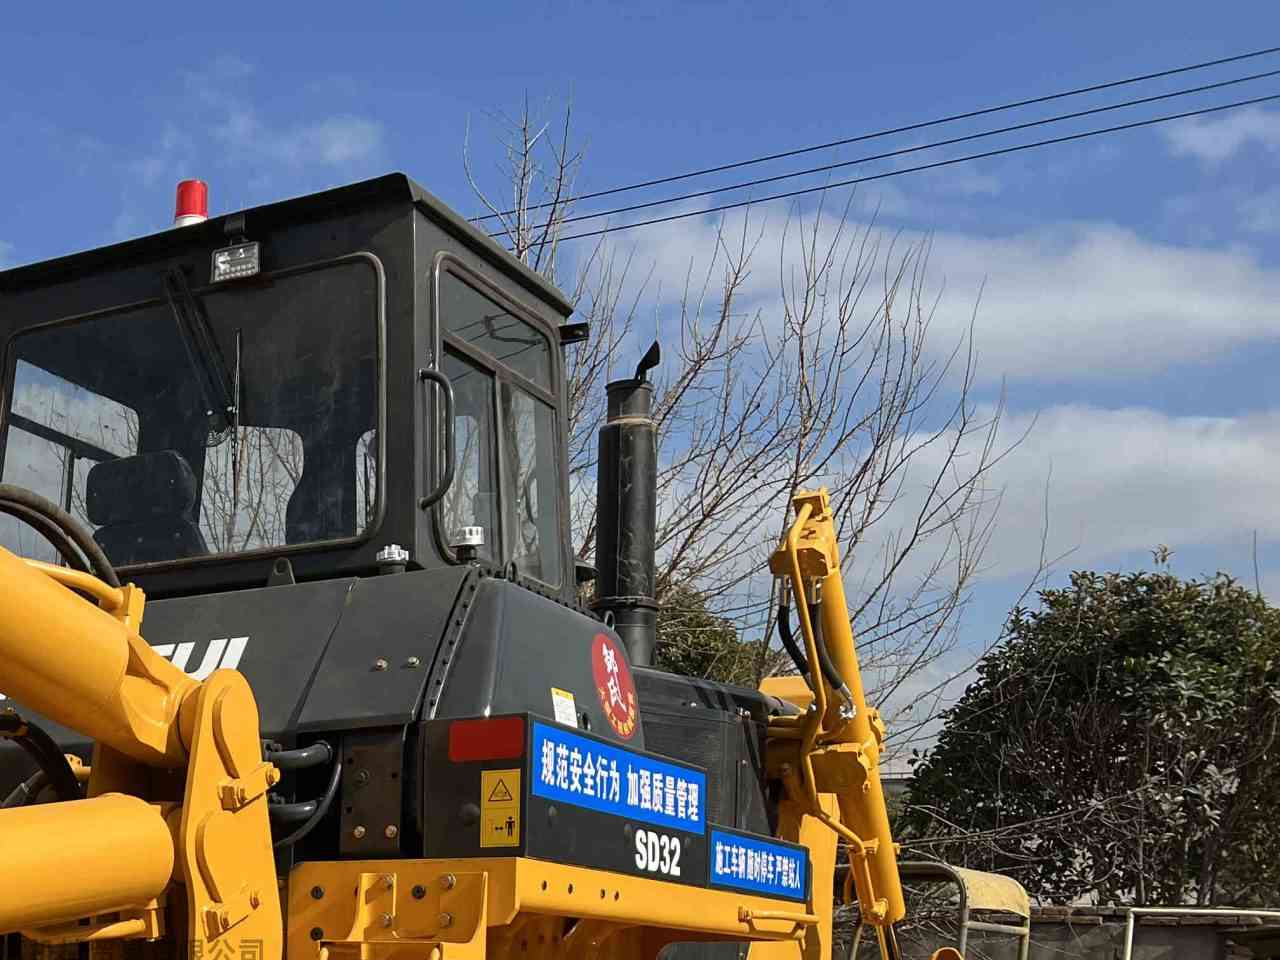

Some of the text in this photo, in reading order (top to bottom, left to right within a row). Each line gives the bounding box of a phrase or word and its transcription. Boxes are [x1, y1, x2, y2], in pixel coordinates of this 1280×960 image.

[541, 738, 699, 822] 规范安全行为 加强质量管理
[635, 829, 681, 876] SD32
